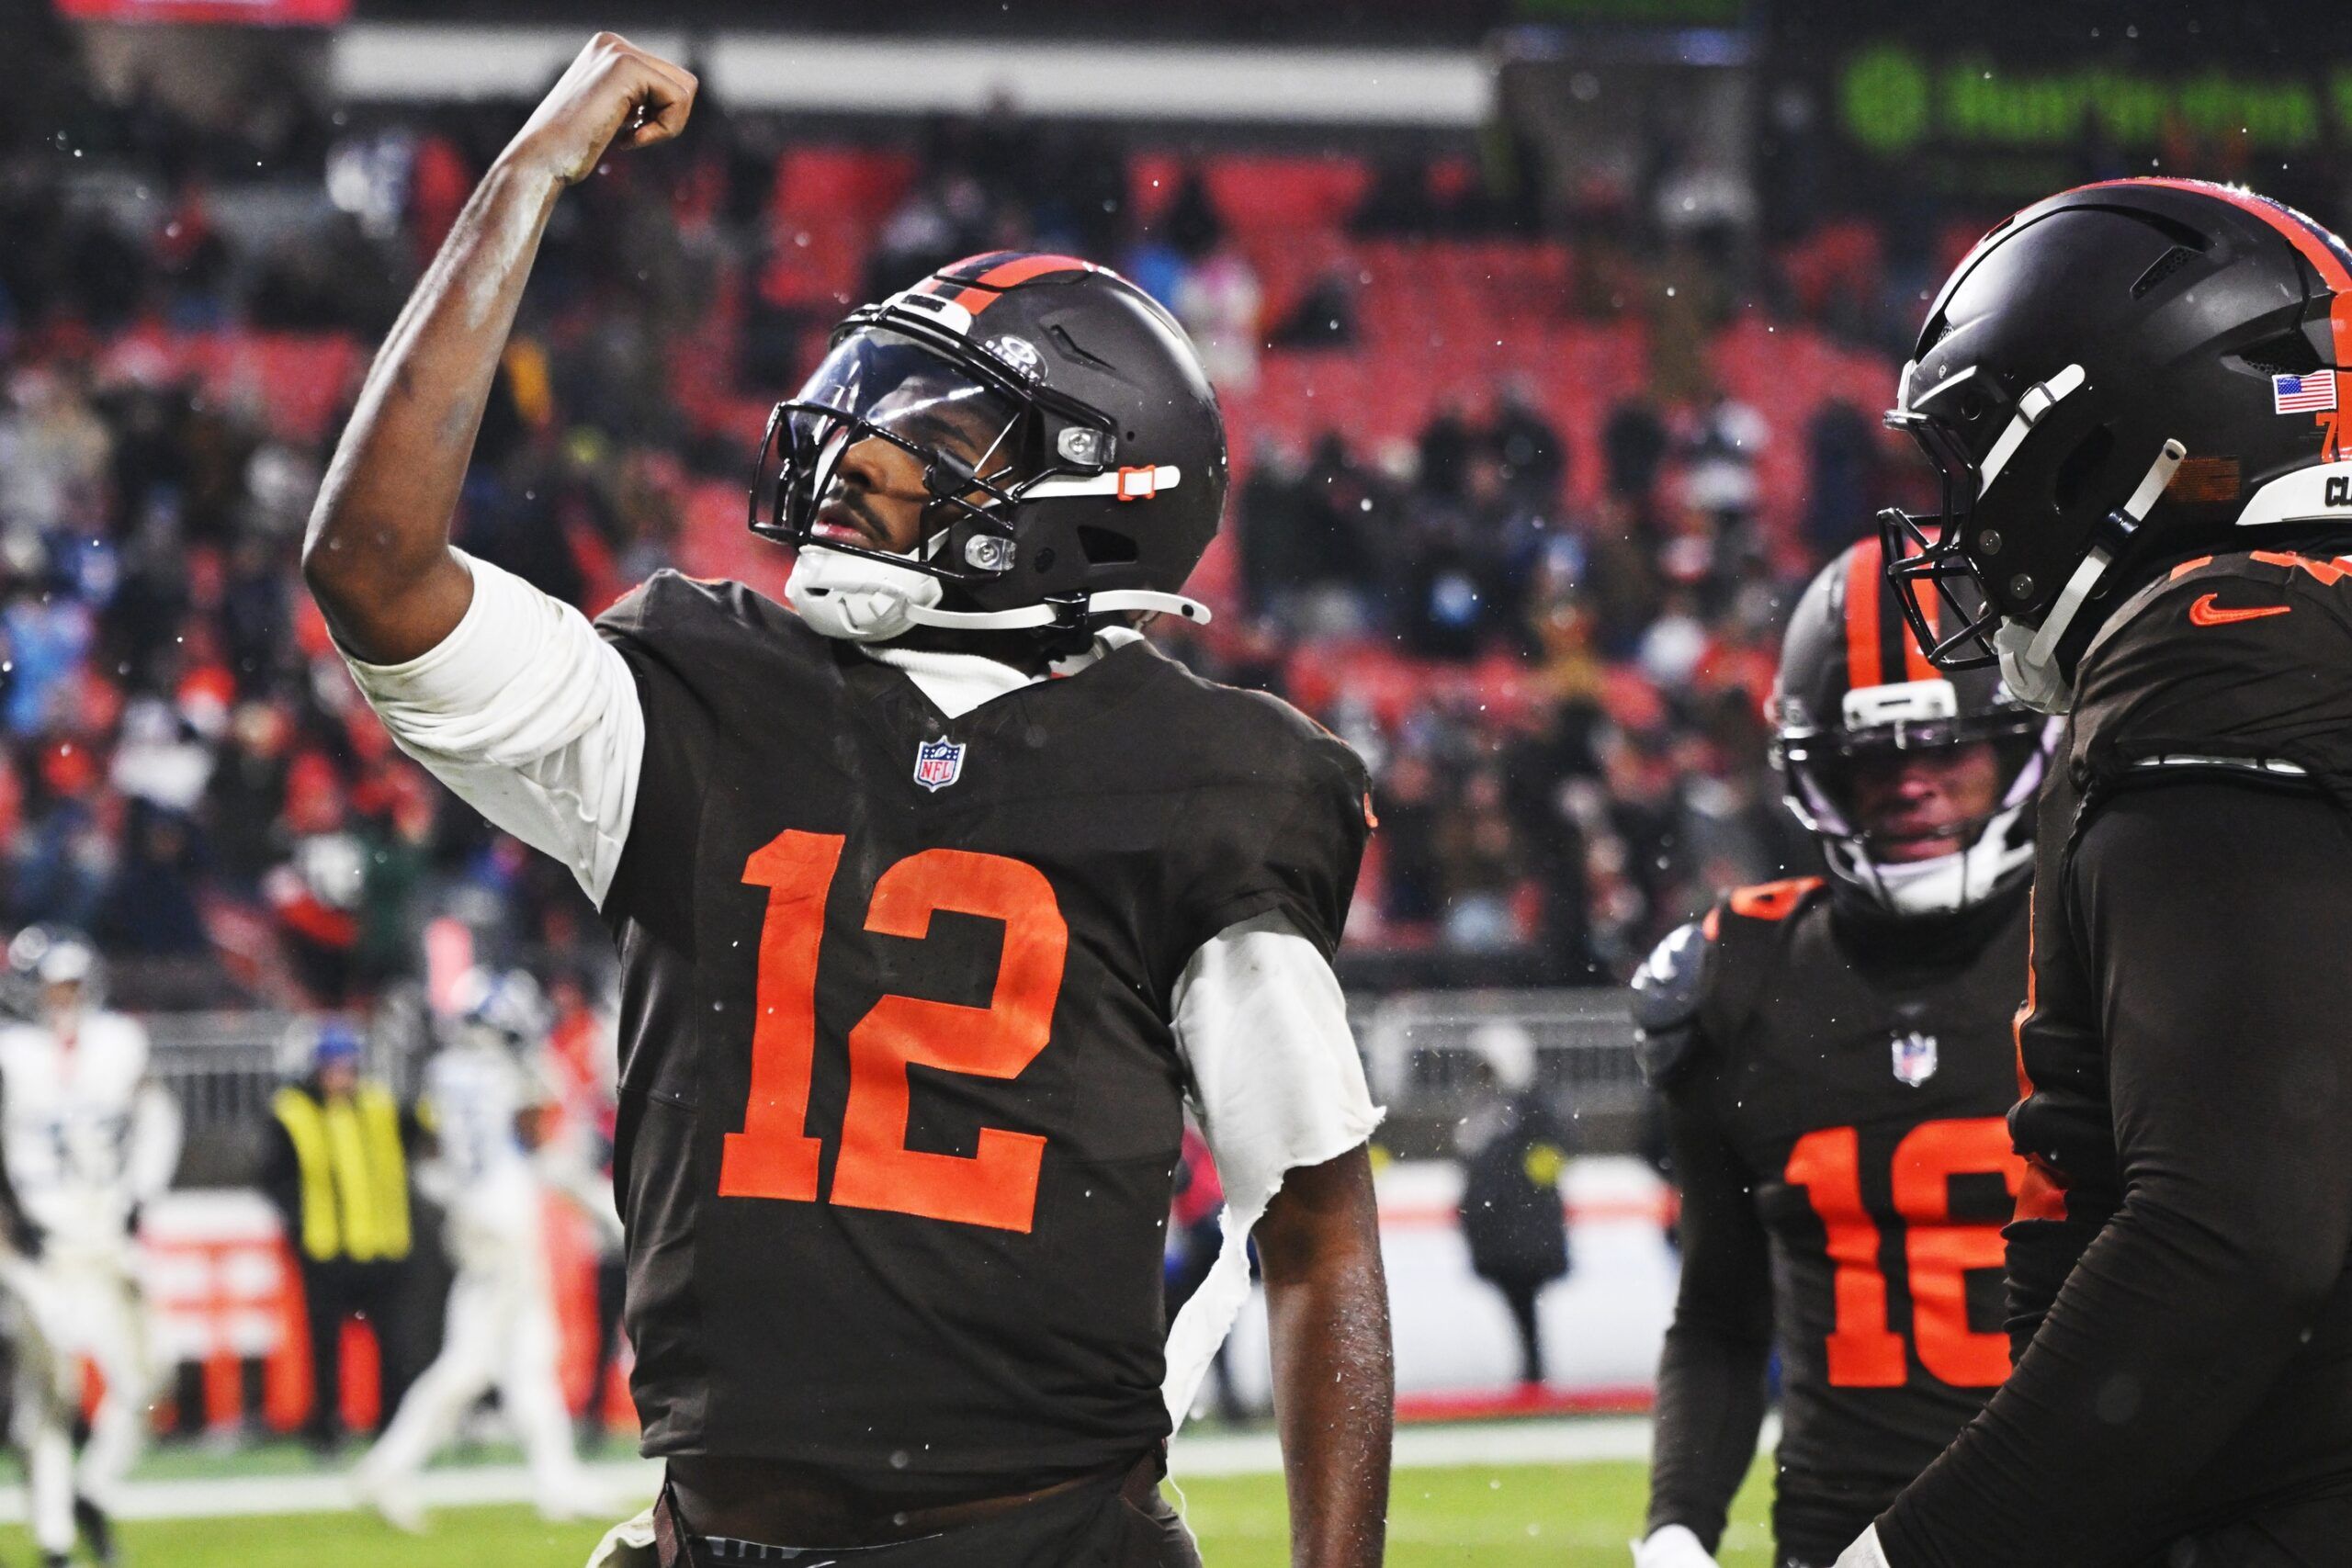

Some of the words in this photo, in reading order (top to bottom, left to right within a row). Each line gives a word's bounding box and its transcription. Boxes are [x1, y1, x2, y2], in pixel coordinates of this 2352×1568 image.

[2324, 476, 2352, 507] CL
[921, 761, 949, 781] NFL
[718, 829, 1069, 1234] 12
